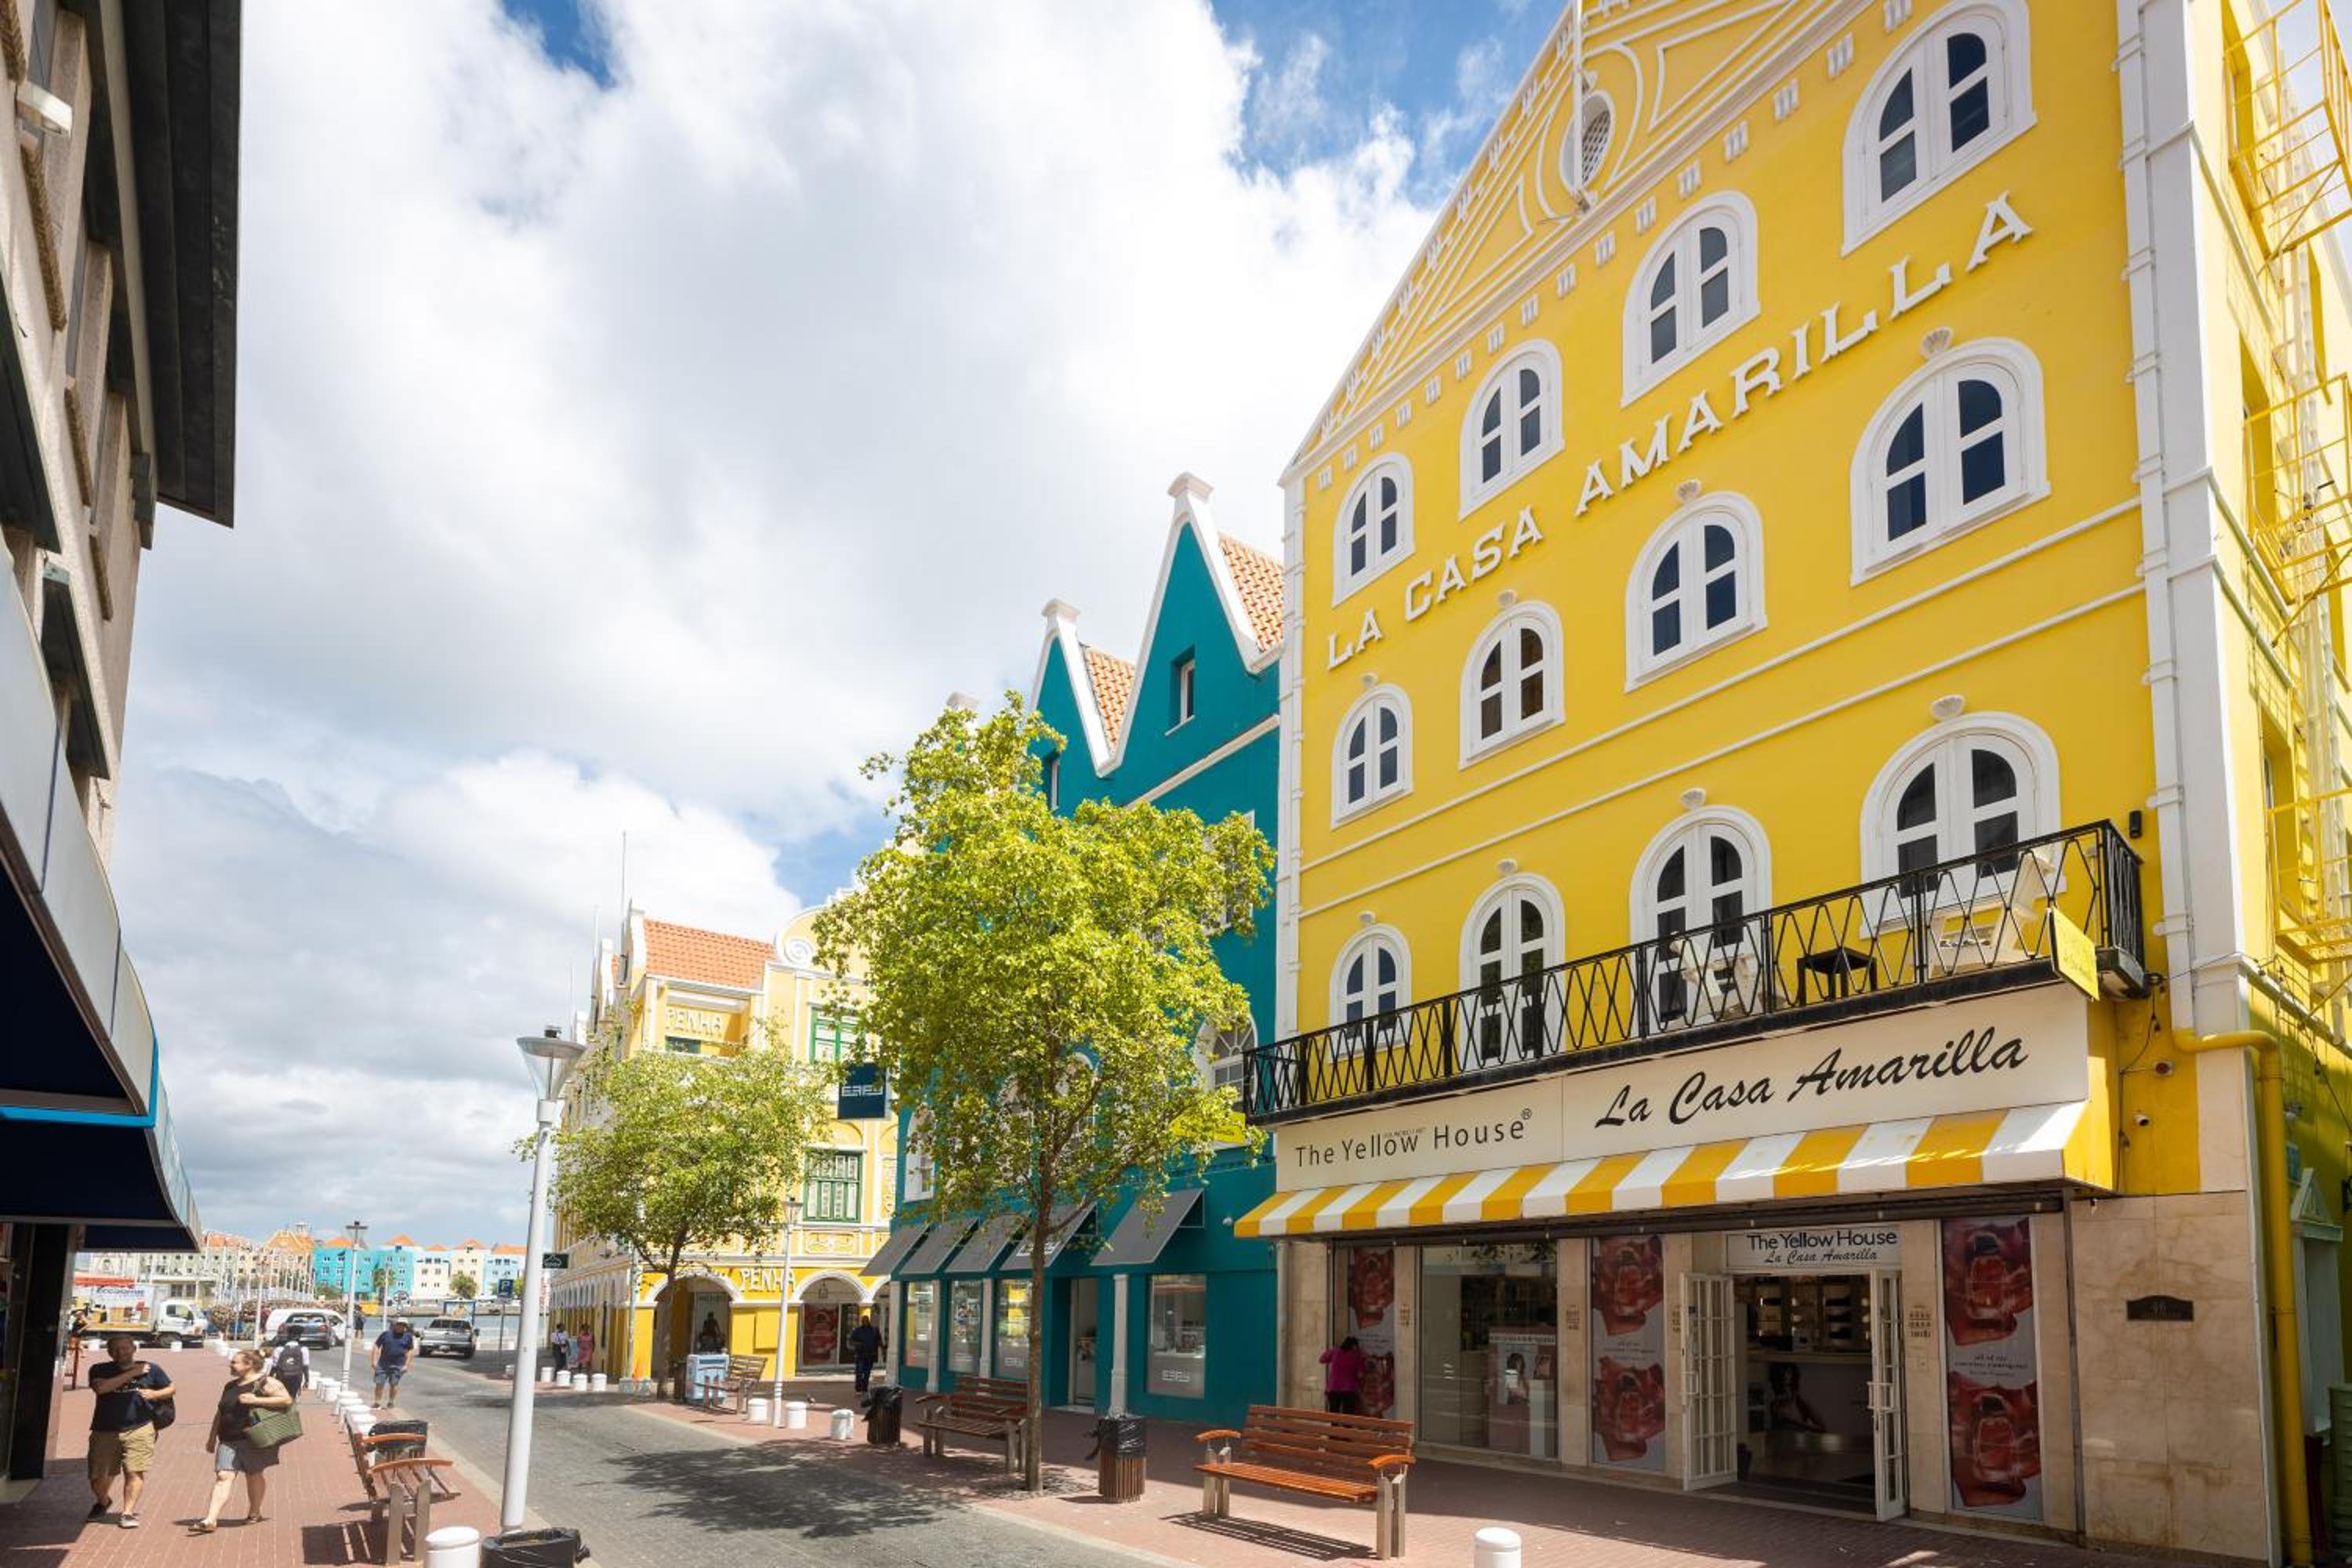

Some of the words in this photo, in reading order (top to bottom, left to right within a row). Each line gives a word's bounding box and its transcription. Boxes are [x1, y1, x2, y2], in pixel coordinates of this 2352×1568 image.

[1327, 608, 1383, 670] LA
[1404, 504, 1544, 622] CASA
[1574, 191, 2034, 517] AMARILLA
[1595, 1084, 1653, 1129] La
[1668, 1070, 1776, 1125] Casa
[1787, 1026, 2029, 1103] Amarilla
[1295, 1144, 1335, 1167] The
[1341, 1134, 1419, 1161] Yellow
[1747, 1234, 1778, 1250] The
[1779, 1232, 1835, 1249] Yellow
[1837, 1230, 1897, 1247] House
[1765, 1250, 1781, 1264] La
[1786, 1250, 1817, 1265] Casa
[1821, 1247, 1877, 1262] Amarilla
